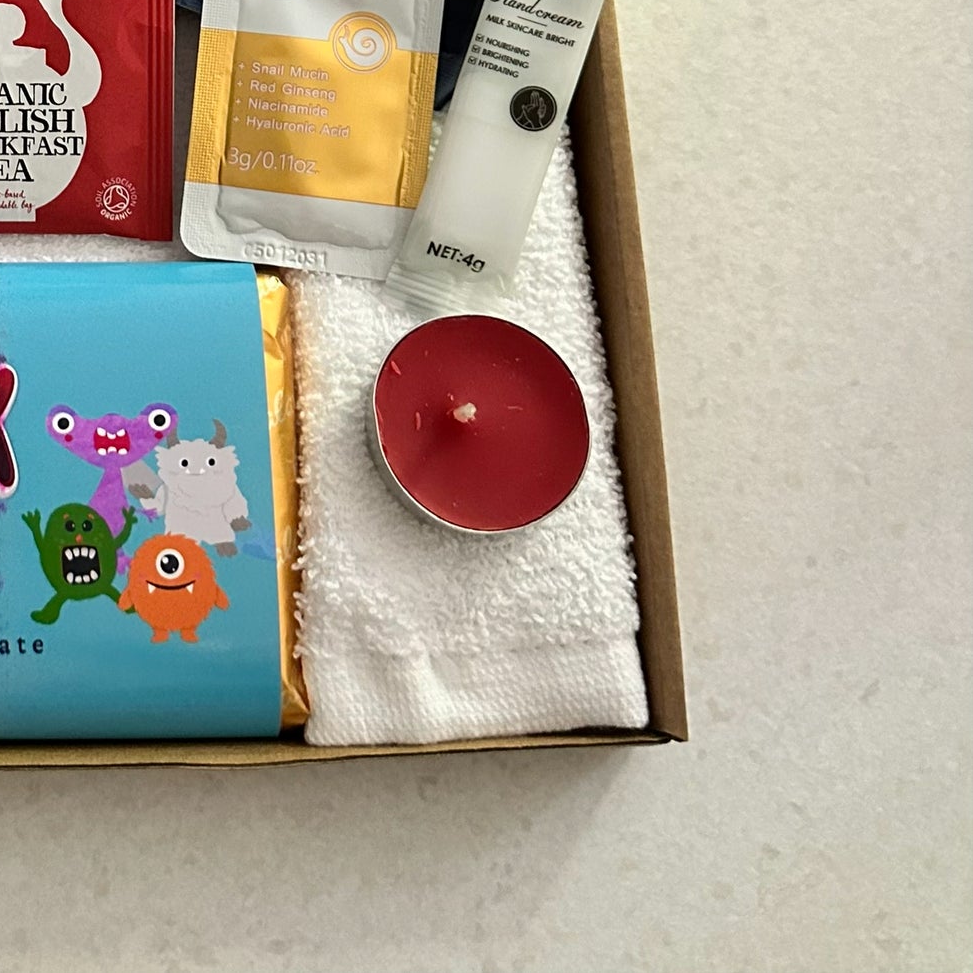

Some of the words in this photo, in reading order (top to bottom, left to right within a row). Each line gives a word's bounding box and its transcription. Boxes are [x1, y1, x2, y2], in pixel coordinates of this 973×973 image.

[486, 14, 505, 26] MILK
[506, 20, 544, 39] SKINCARE
[545, 33, 575, 48] BRIGHT
[485, 37, 530, 57] NOURISHING
[481, 48, 529, 69] BRIGHTENING
[252, 62, 284, 76] Snail
[290, 65, 329, 80] Mucin
[477, 60, 519, 78] HYDRATING
[250, 80, 276, 93] Red
[282, 83, 337, 103] Ginseng
[248, 98, 329, 117] Niacinamide
[246, 116, 315, 134] Hyaluronic
[320, 124, 350, 138] Acid
[95, 189, 104, 207] SOIL
[102, 177, 138, 207] ASSOCIATION
[100, 208, 132, 221] ORGANIC
